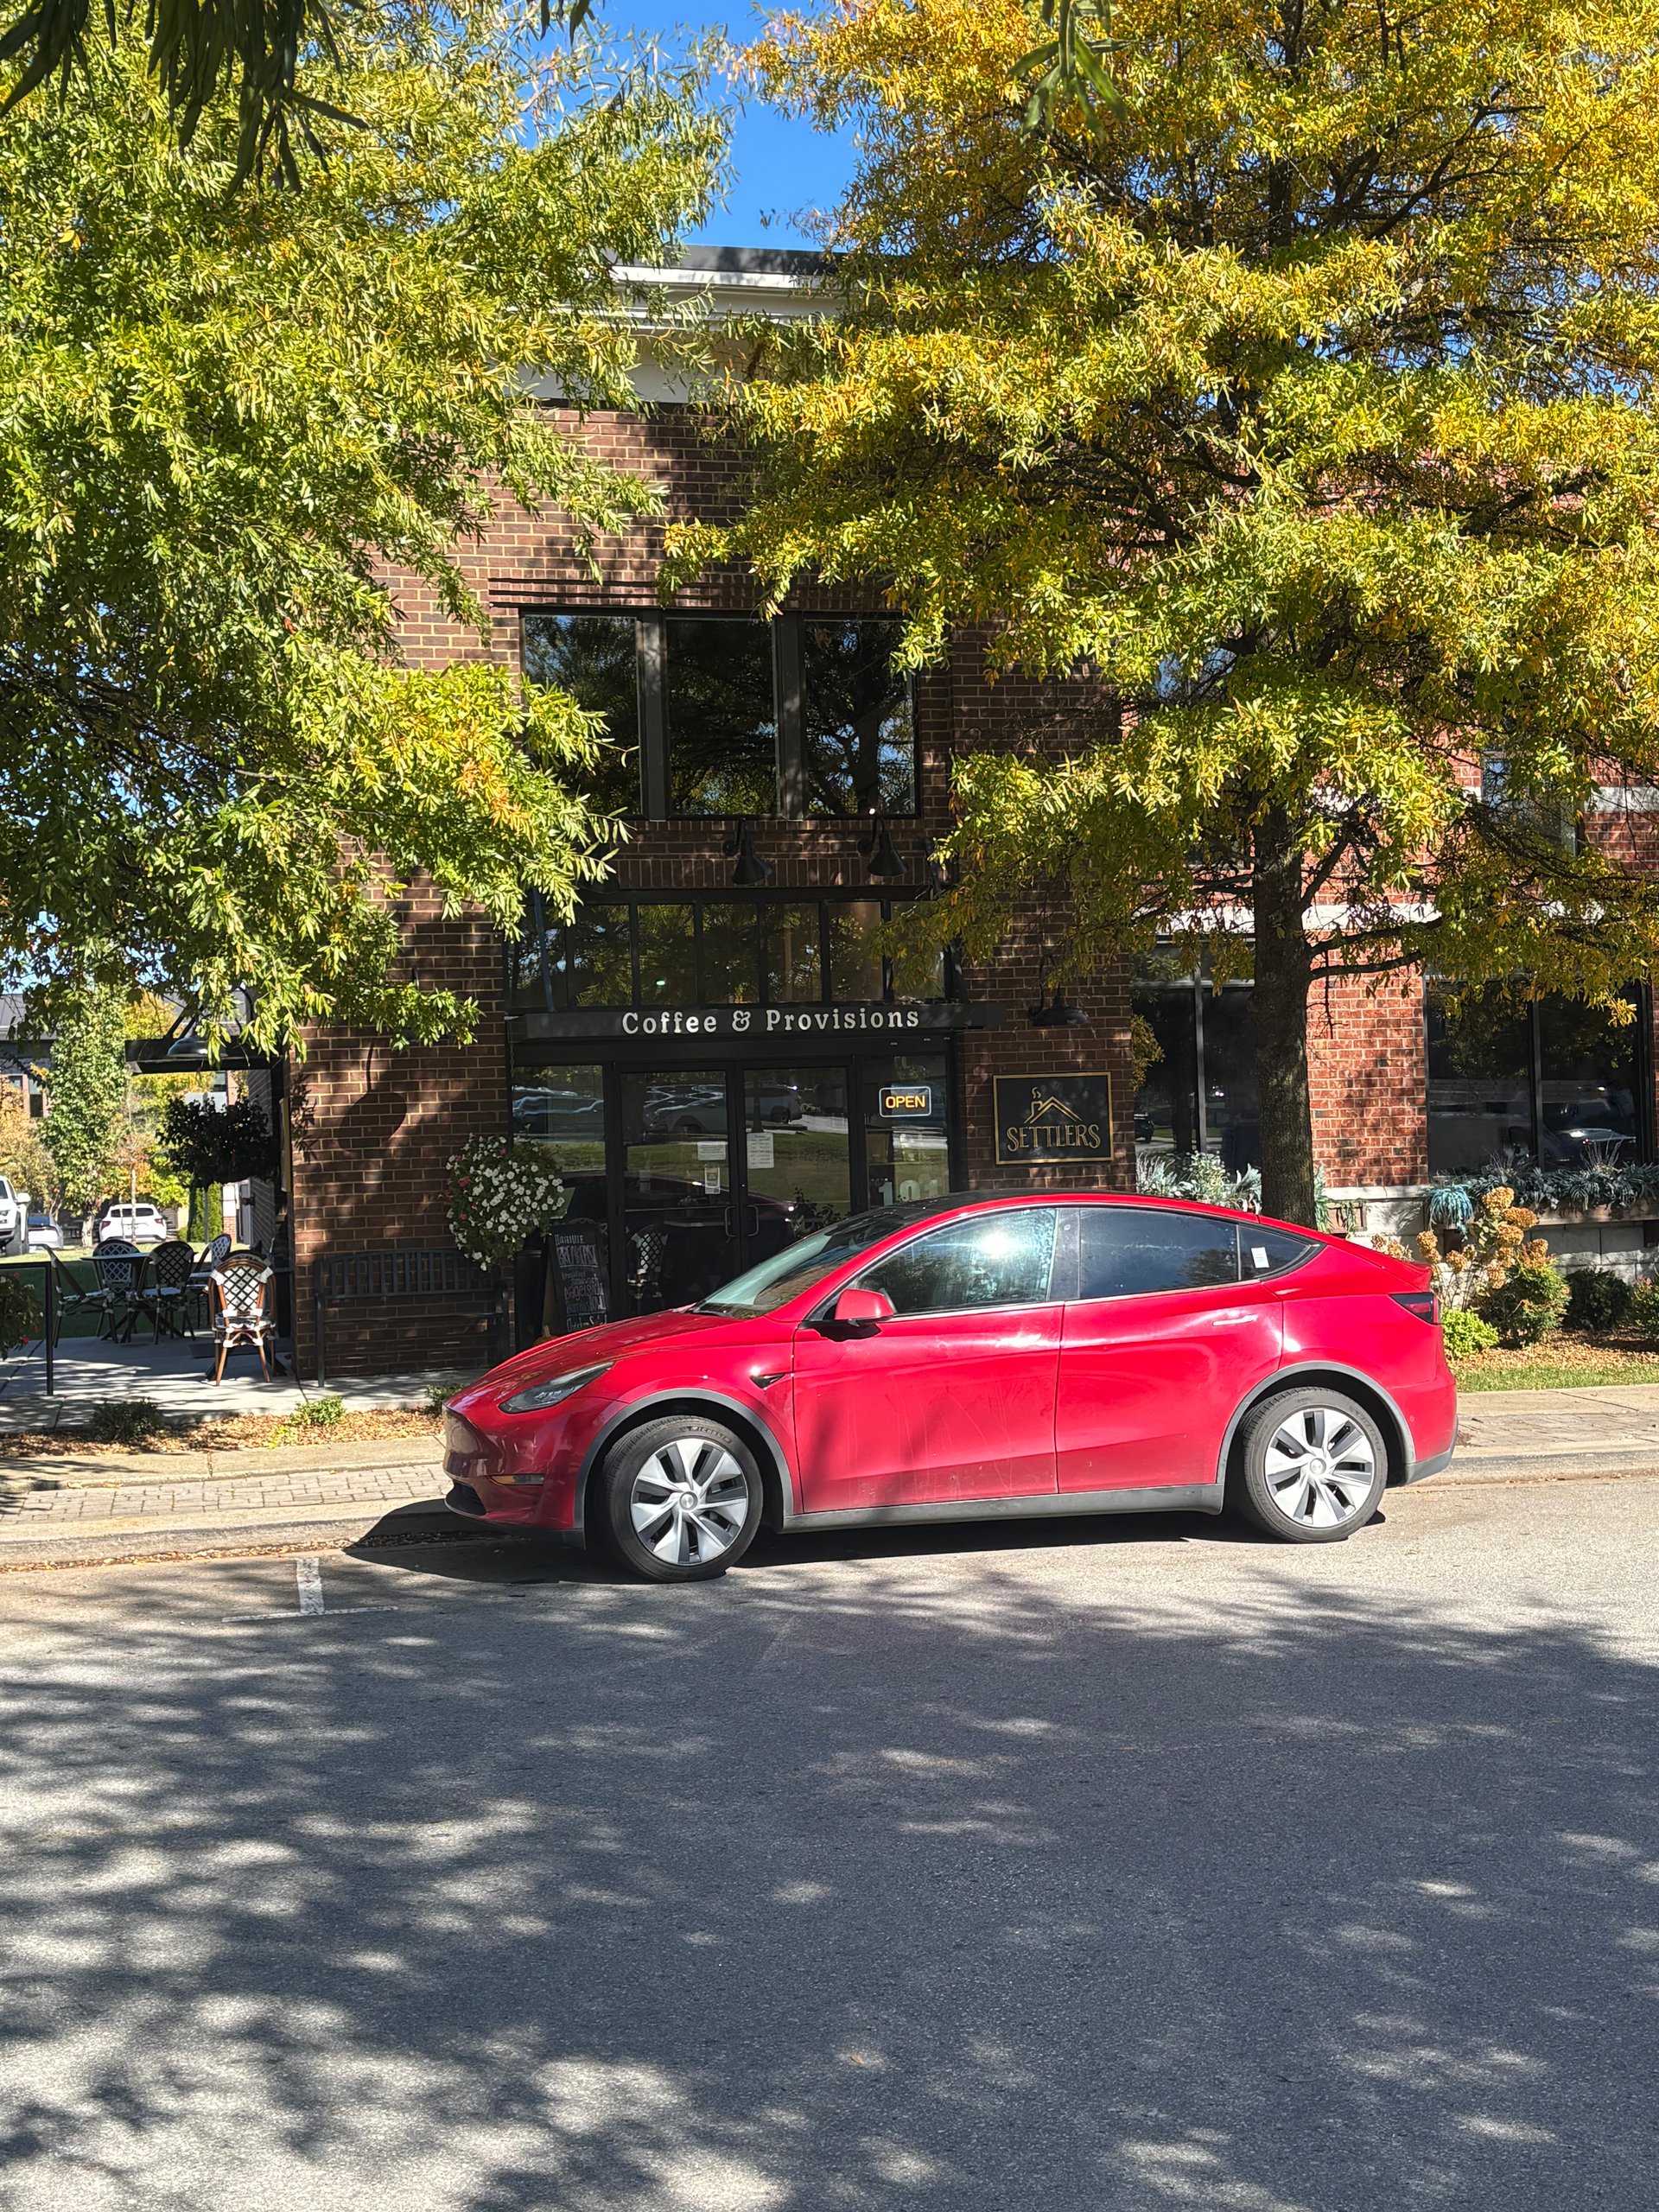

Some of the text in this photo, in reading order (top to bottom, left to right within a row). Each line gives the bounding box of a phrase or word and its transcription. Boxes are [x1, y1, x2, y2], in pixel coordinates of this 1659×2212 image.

[622, 1007, 918, 1034] Coffee & Provisions
[886, 1096, 925, 1109] OPEN
[1007, 1124, 1101, 1152] SETTLERS
